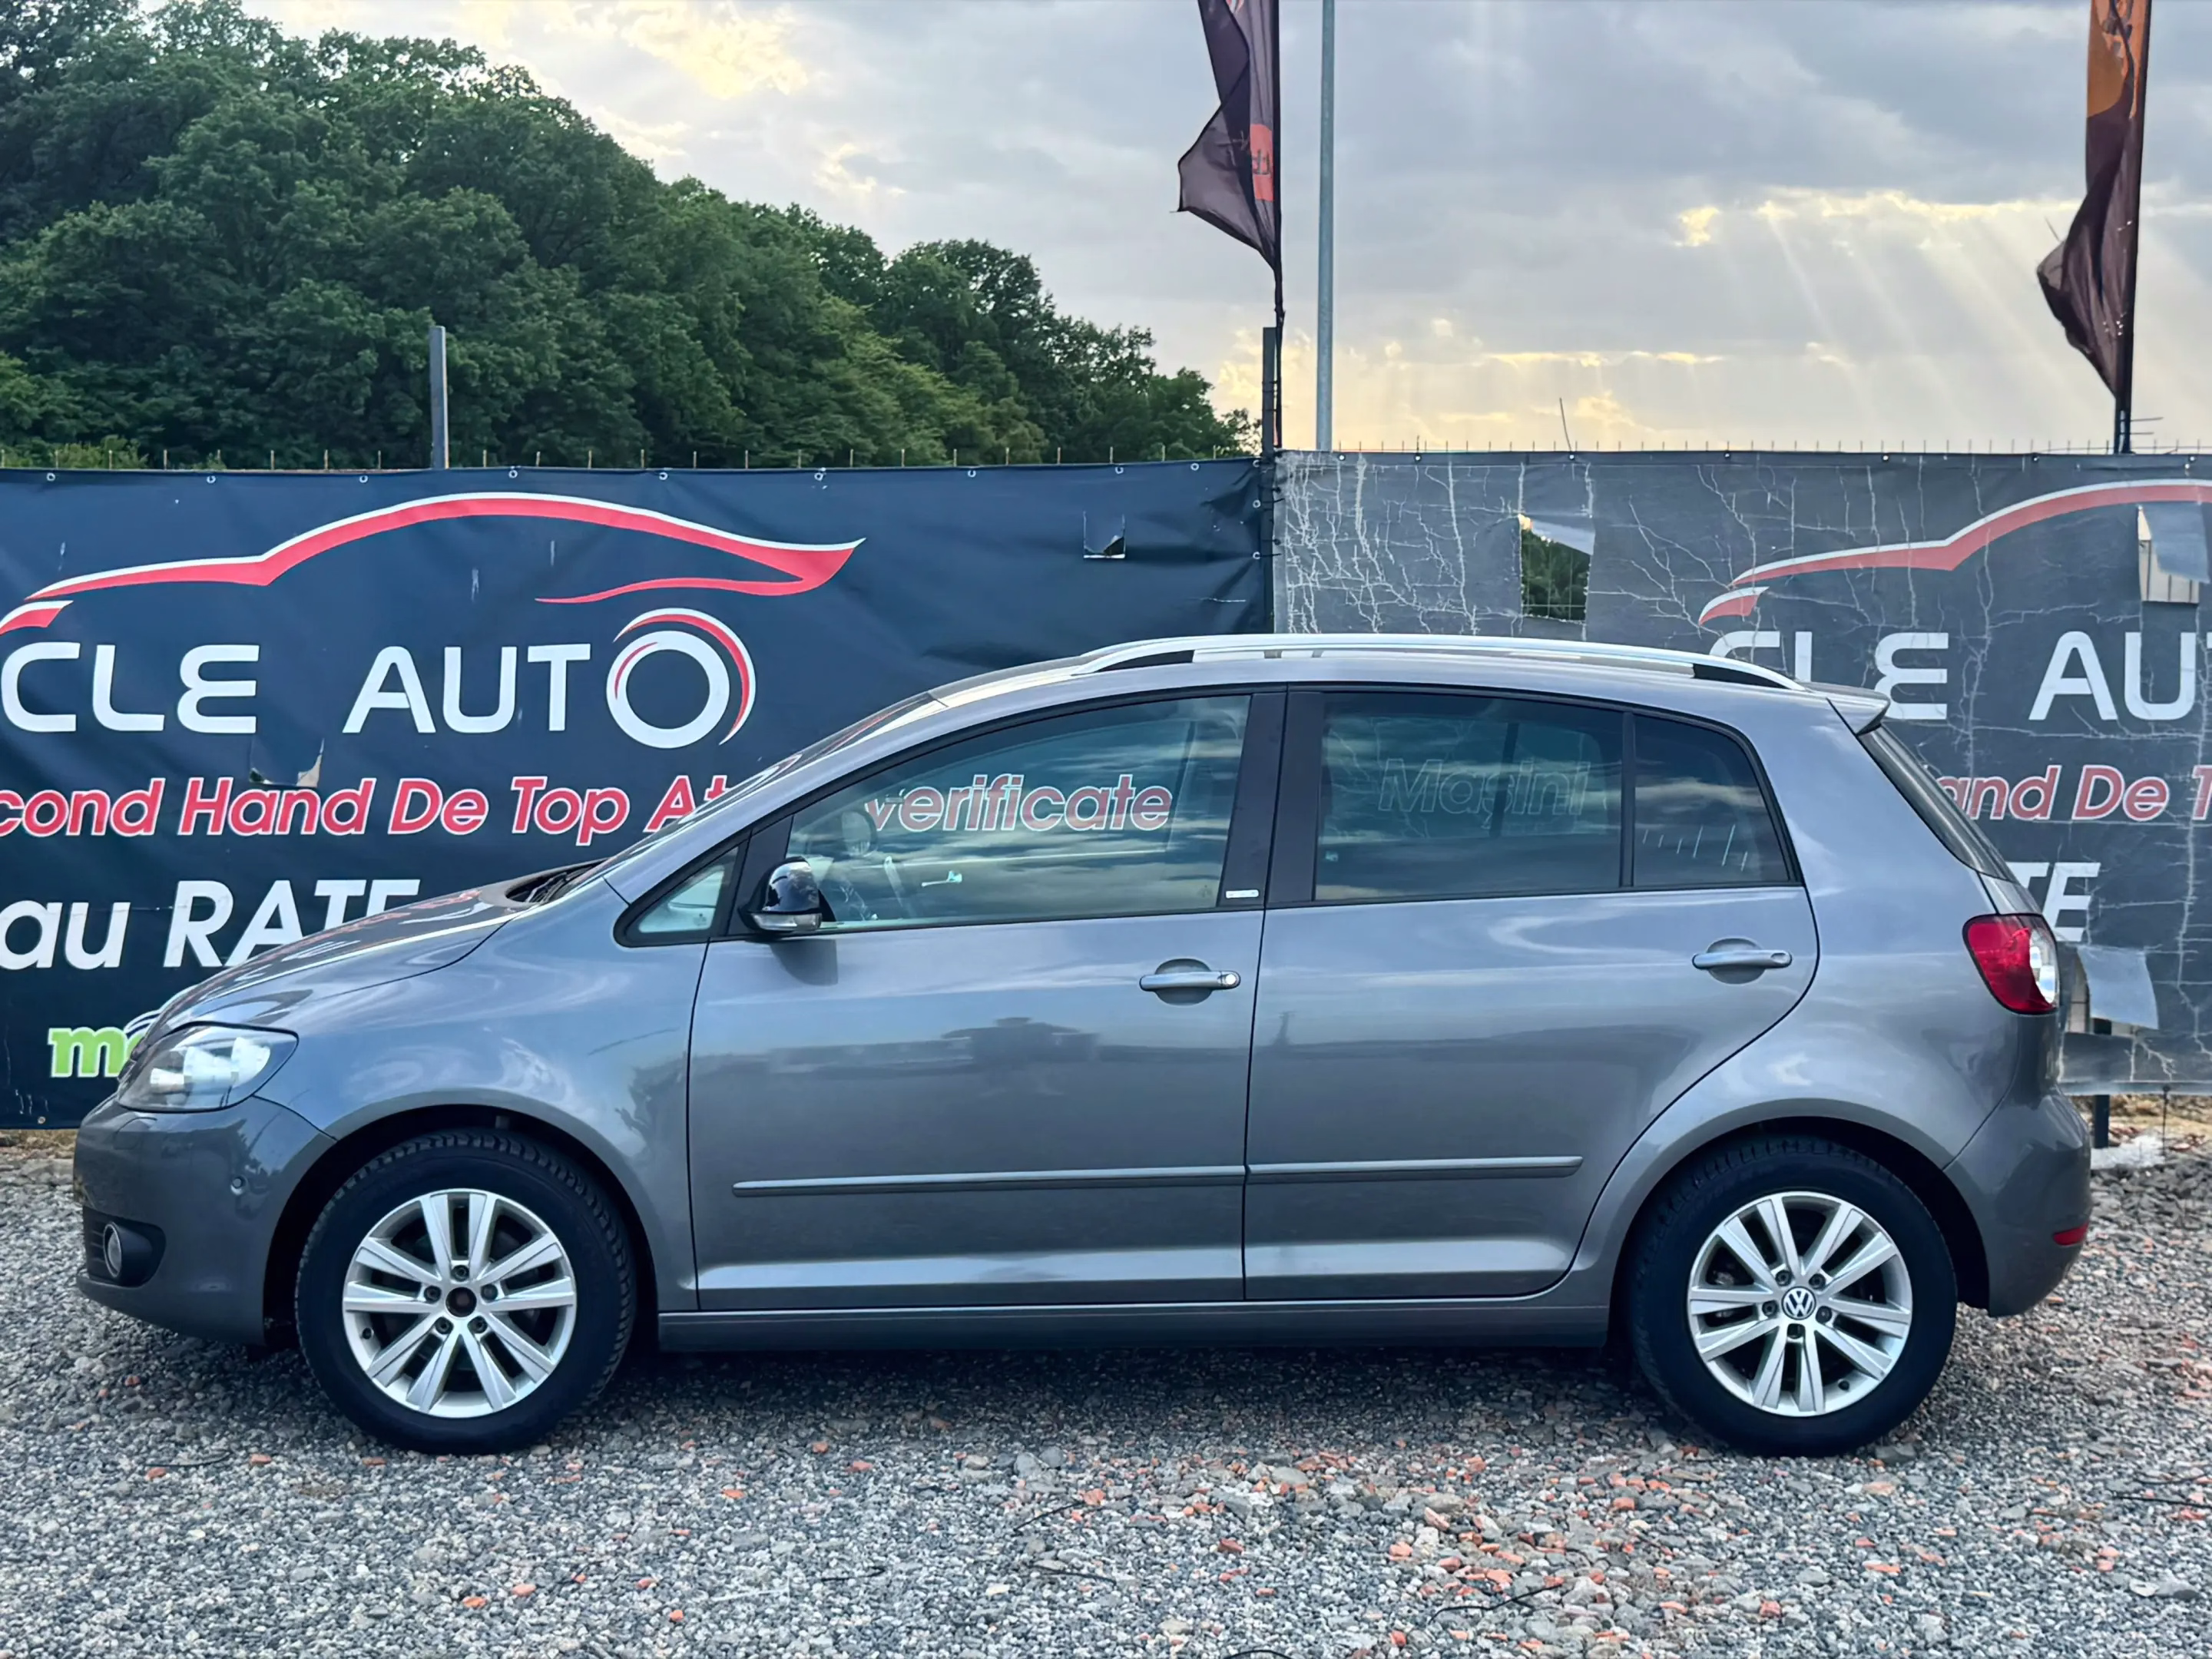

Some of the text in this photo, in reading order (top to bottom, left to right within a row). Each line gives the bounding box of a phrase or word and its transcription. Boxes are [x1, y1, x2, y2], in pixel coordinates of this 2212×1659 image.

[2, 628, 730, 749] CLE AUTO
[2028, 631, 2212, 720] AU
[177, 777, 377, 837] Hand
[386, 778, 488, 836] De
[511, 775, 631, 847] Top
[864, 773, 1174, 833] verificate
[2071, 764, 2171, 822] De
[0, 900, 131, 970] au
